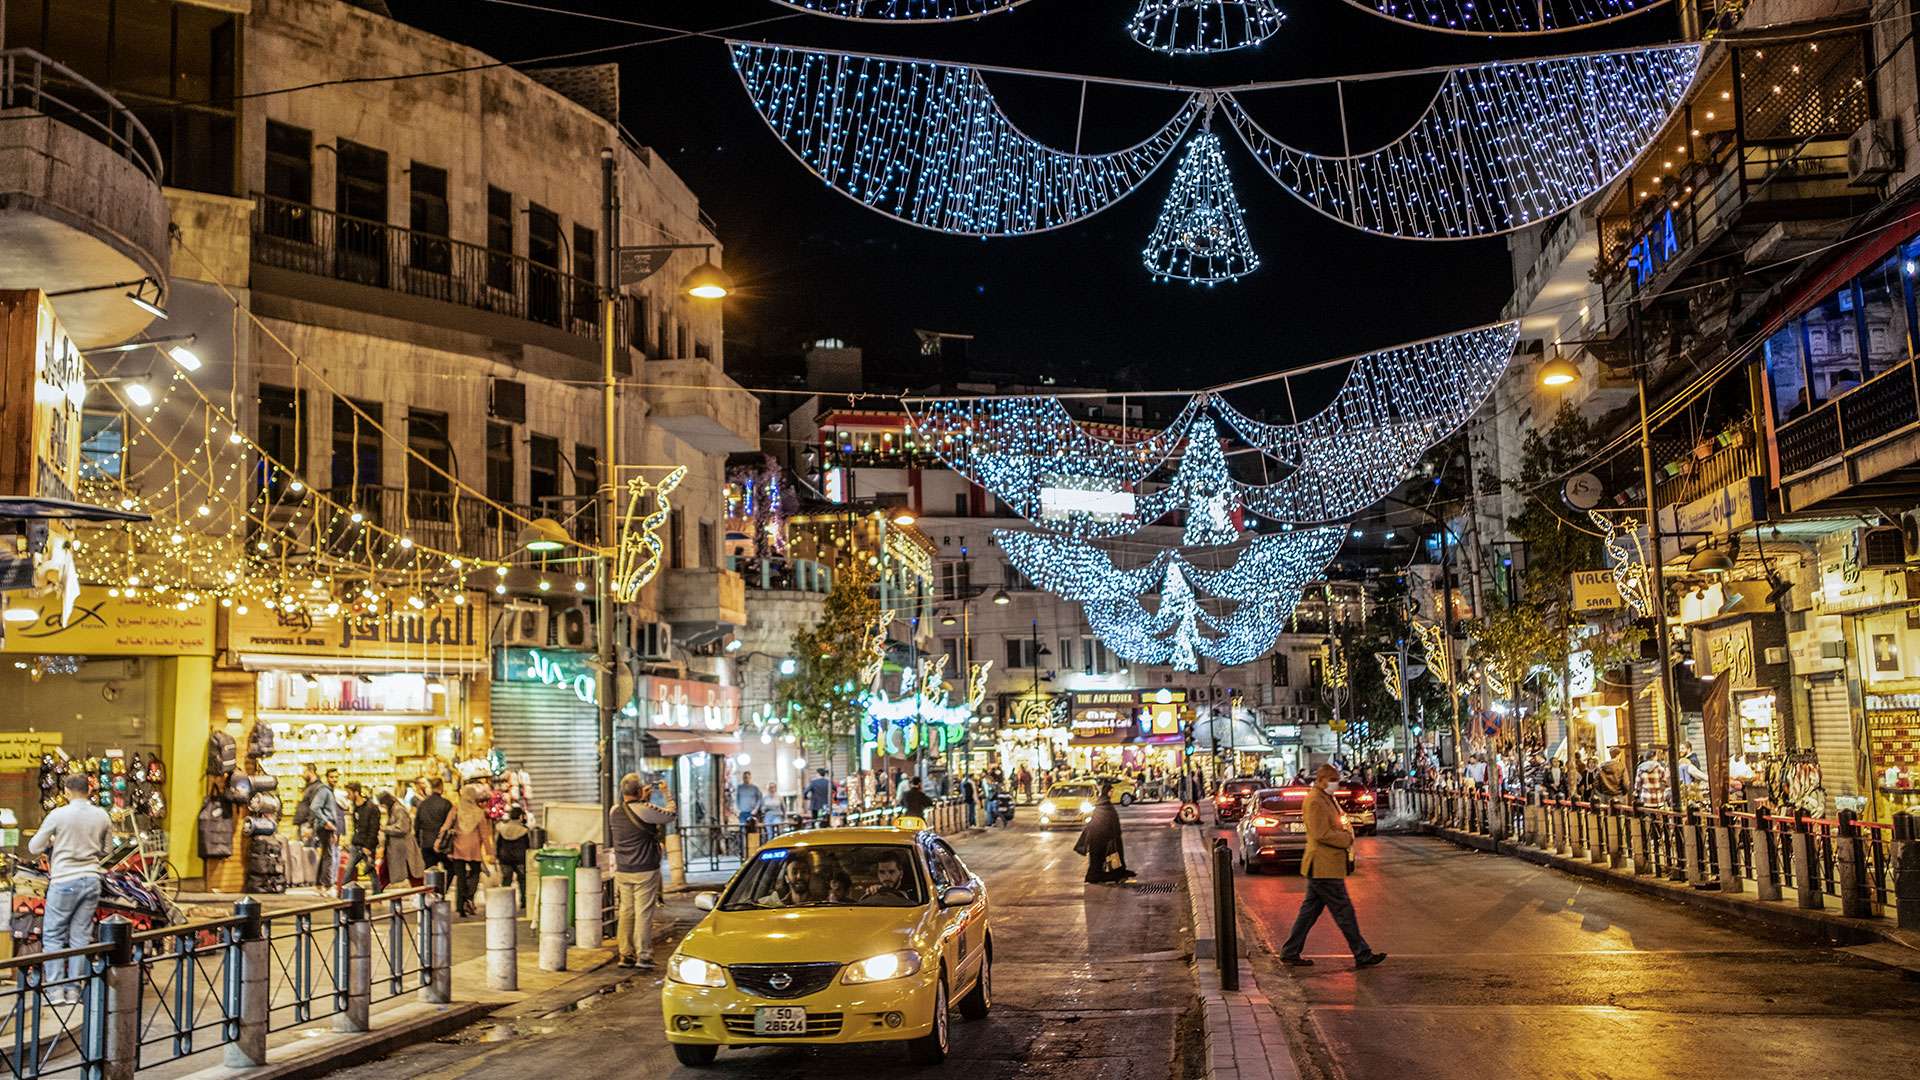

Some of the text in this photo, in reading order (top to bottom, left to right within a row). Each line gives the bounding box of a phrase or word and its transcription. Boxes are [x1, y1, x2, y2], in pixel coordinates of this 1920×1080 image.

[1585, 597, 1613, 607] SARA
[1110, 694, 1132, 703] HOTEL
[777, 1009, 791, 1019] 50
[765, 1021, 802, 1031] 28624
